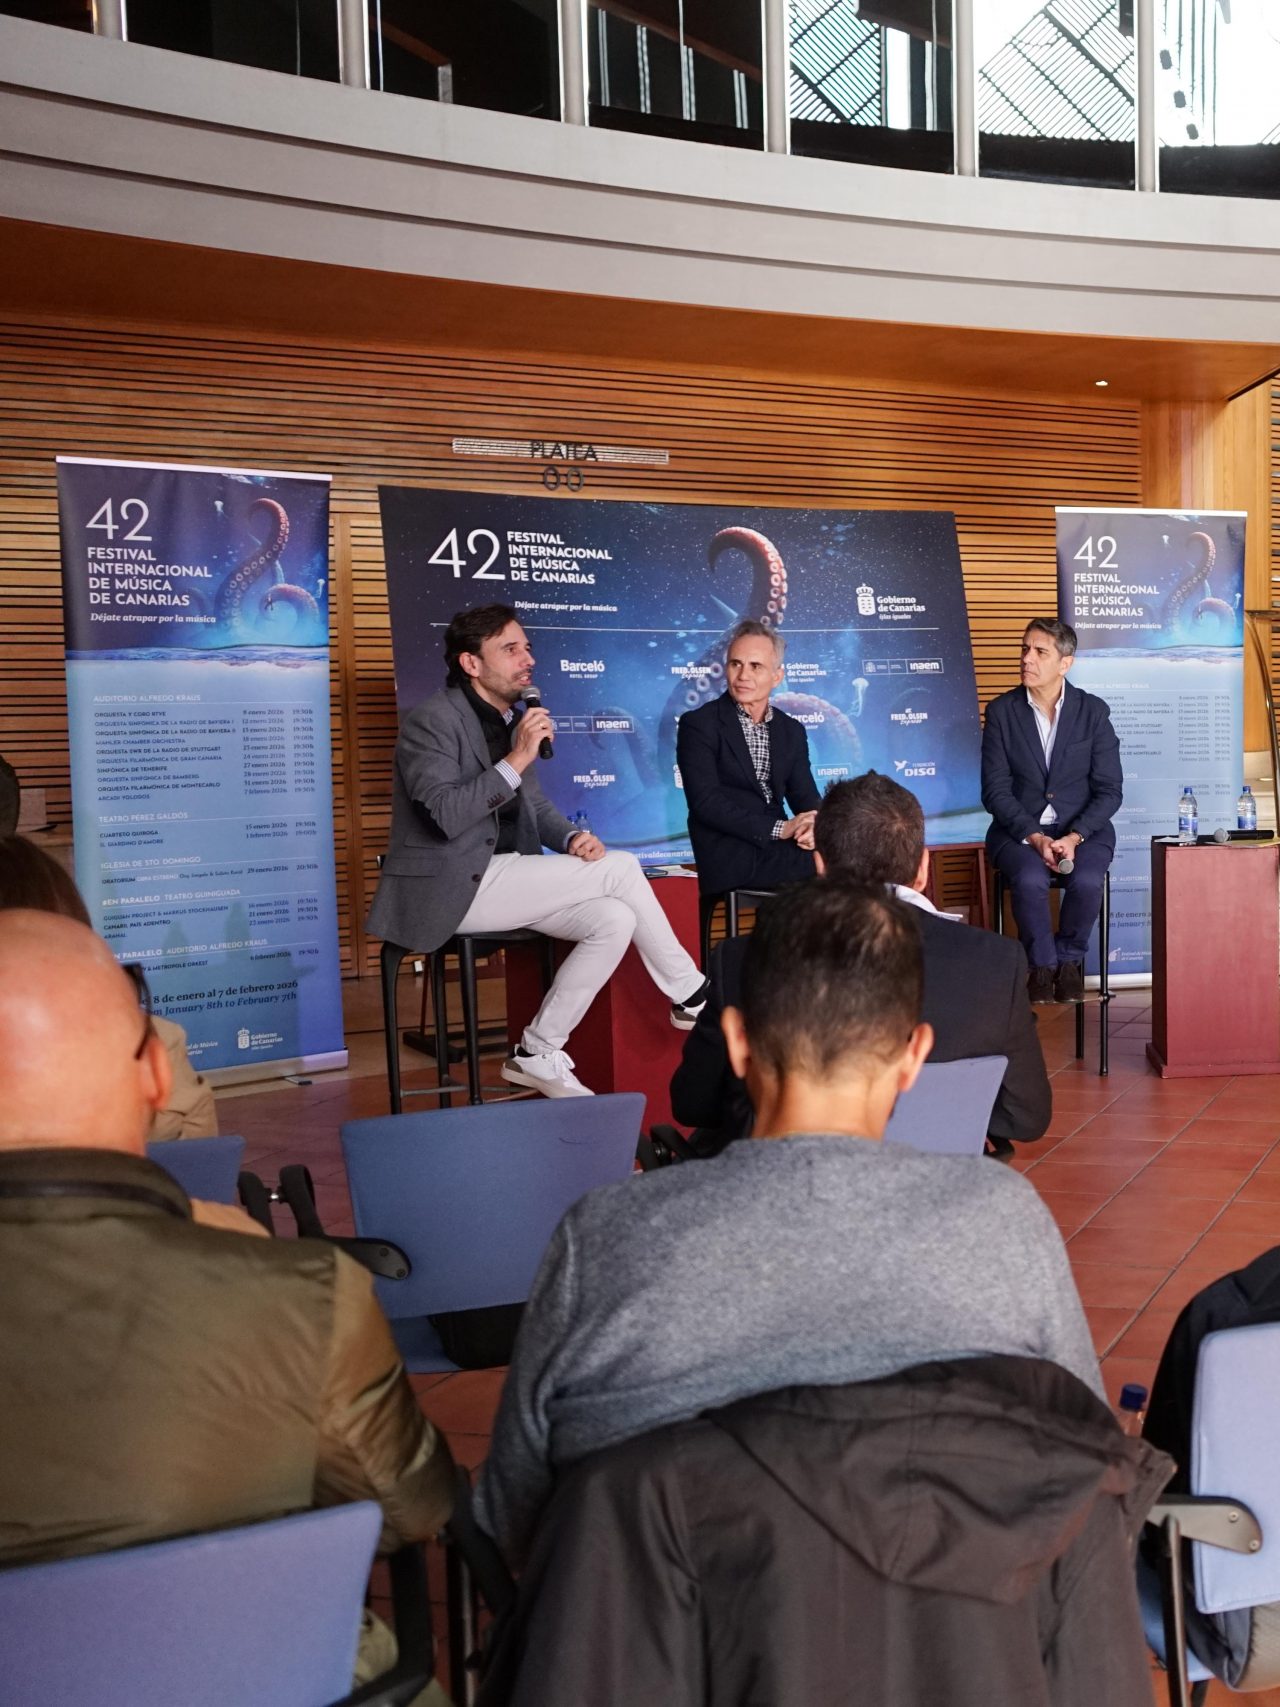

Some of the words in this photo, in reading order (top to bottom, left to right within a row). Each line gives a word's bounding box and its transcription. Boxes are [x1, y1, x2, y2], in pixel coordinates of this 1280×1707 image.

[530, 440, 599, 462] PLATEA
[85, 497, 152, 541] 42
[507, 531, 565, 545] FESTIVAL
[87, 547, 157, 561] FESTIVAL
[427, 527, 506, 580] 42
[508, 544, 613, 560] INTERNACIONAL
[1073, 535, 1118, 568] 42
[88, 562, 212, 578] INTERNACIONAL
[509, 558, 528, 569] DE
[531, 557, 580, 571] MÚSICA
[88, 577, 110, 590] DE
[115, 576, 172, 591] MÚSICA
[511, 570, 529, 581] DE
[532, 571, 595, 585] CANARIAS
[1074, 573, 1121, 583] FESTIVAL
[1074, 584, 1160, 594] INTERNACIONAL
[89, 593, 111, 605] DE
[115, 593, 190, 606] CANARIAS
[514, 600, 539, 610] Déjate
[540, 603, 568, 612] atrapar
[569, 604, 582, 612] por
[583, 603, 591, 611] la
[592, 604, 618, 612] música
[876, 595, 916, 604] Gobierno
[1074, 596, 1090, 605] DE
[1091, 594, 1131, 605] MÚSICA
[878, 604, 889, 612] de
[889, 604, 926, 612] Canarias
[1075, 607, 1090, 616] DE
[1092, 607, 1144, 616] CANARIAS
[90, 612, 120, 624] Déjate
[122, 615, 157, 625] atrapar
[158, 615, 173, 625] por
[175, 613, 184, 623] la
[185, 614, 217, 624] música
[560, 659, 605, 672] Barceló
[786, 662, 819, 670] Gobierno
[787, 669, 797, 677] de
[796, 669, 827, 677] Canarias
[100, 861, 131, 869] IGLESIA
[162, 856, 201, 865] DOMINGO
[120, 895, 160, 905] PARALELO
[164, 892, 193, 900] TEATRO
[123, 949, 162, 959] PARALELO
[166, 945, 208, 955] AUDITORIO
[209, 941, 243, 951] ALFREDO
[245, 938, 268, 947] KRAUS
[162, 995, 174, 1003] de
[177, 992, 205, 1001] enero
[207, 989, 216, 998] al
[218, 990, 224, 999] 7
[225, 987, 238, 995] de
[239, 983, 275, 994] febrero
[276, 981, 298, 989] 2026
[165, 1003, 205, 1016] January
[206, 1001, 223, 1009] 8th
[237, 995, 279, 1006] February
[281, 992, 297, 1002] 7th
